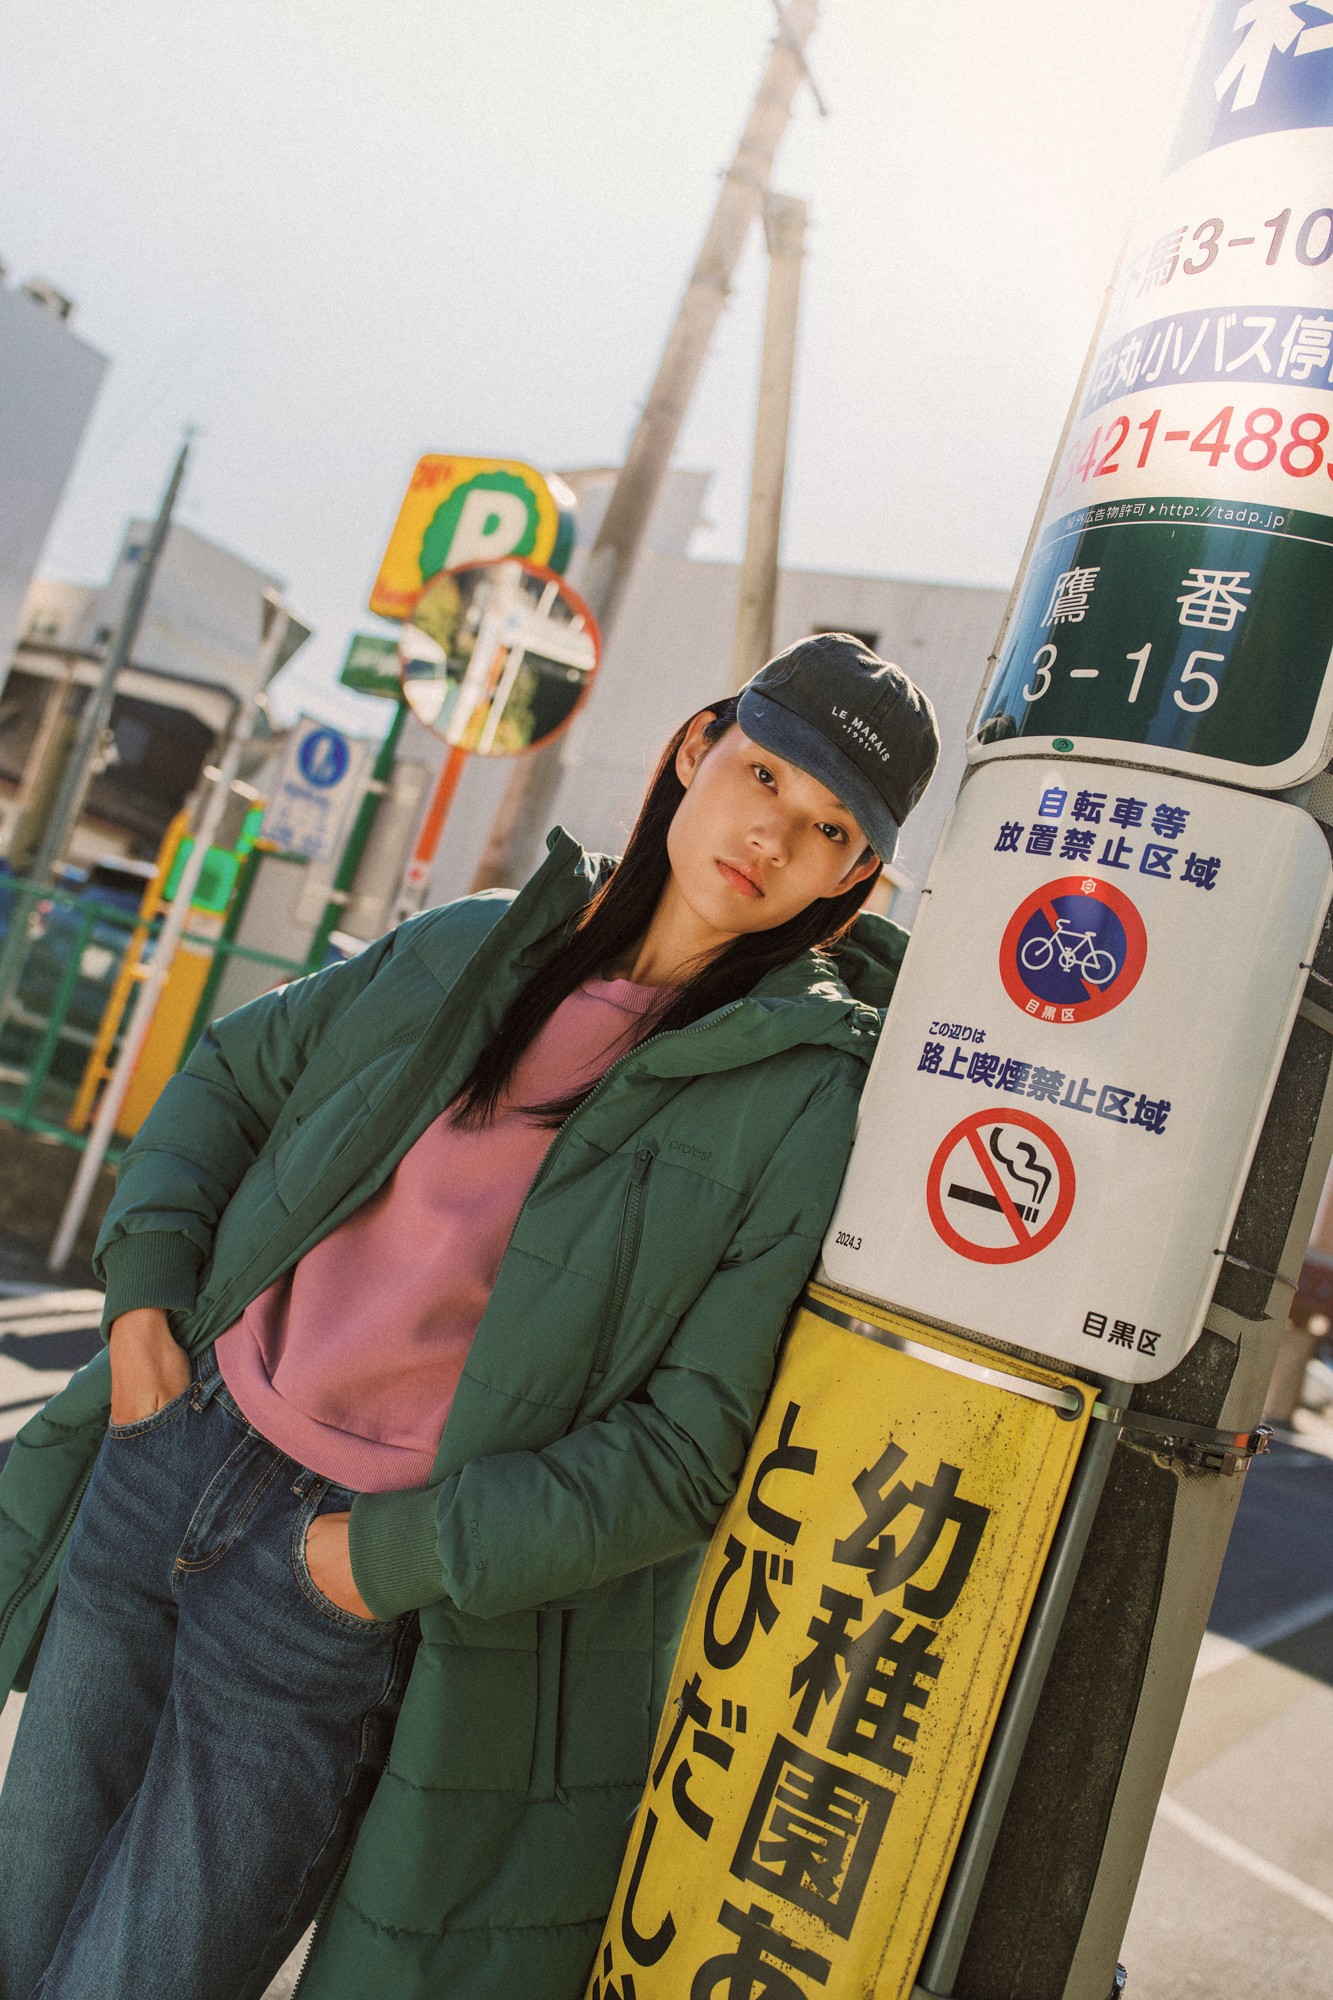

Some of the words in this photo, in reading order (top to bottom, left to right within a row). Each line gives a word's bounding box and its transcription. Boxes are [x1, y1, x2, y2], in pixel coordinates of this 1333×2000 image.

[1092, 313, 1333, 406] 中丸小バス停
[1056, 406, 1333, 500] 3421-488
[443, 488, 529, 567] P
[1159, 502, 1285, 529] http://tadp.jp
[831, 705, 848, 719] LE
[851, 716, 890, 762] MARAIS
[1038, 787, 1191, 840] 自転車等
[993, 821, 1221, 891] 放置禁止区域
[928, 1021, 987, 1044] この辺りは
[1025, 998, 1075, 1022] 目黒区
[917, 1041, 1172, 1135] 路上喫煙禁止区域
[835, 1230, 862, 1251] 2024.3
[1082, 1311, 1162, 1357] 目黒区
[590, 1400, 818, 2000] とびだし
